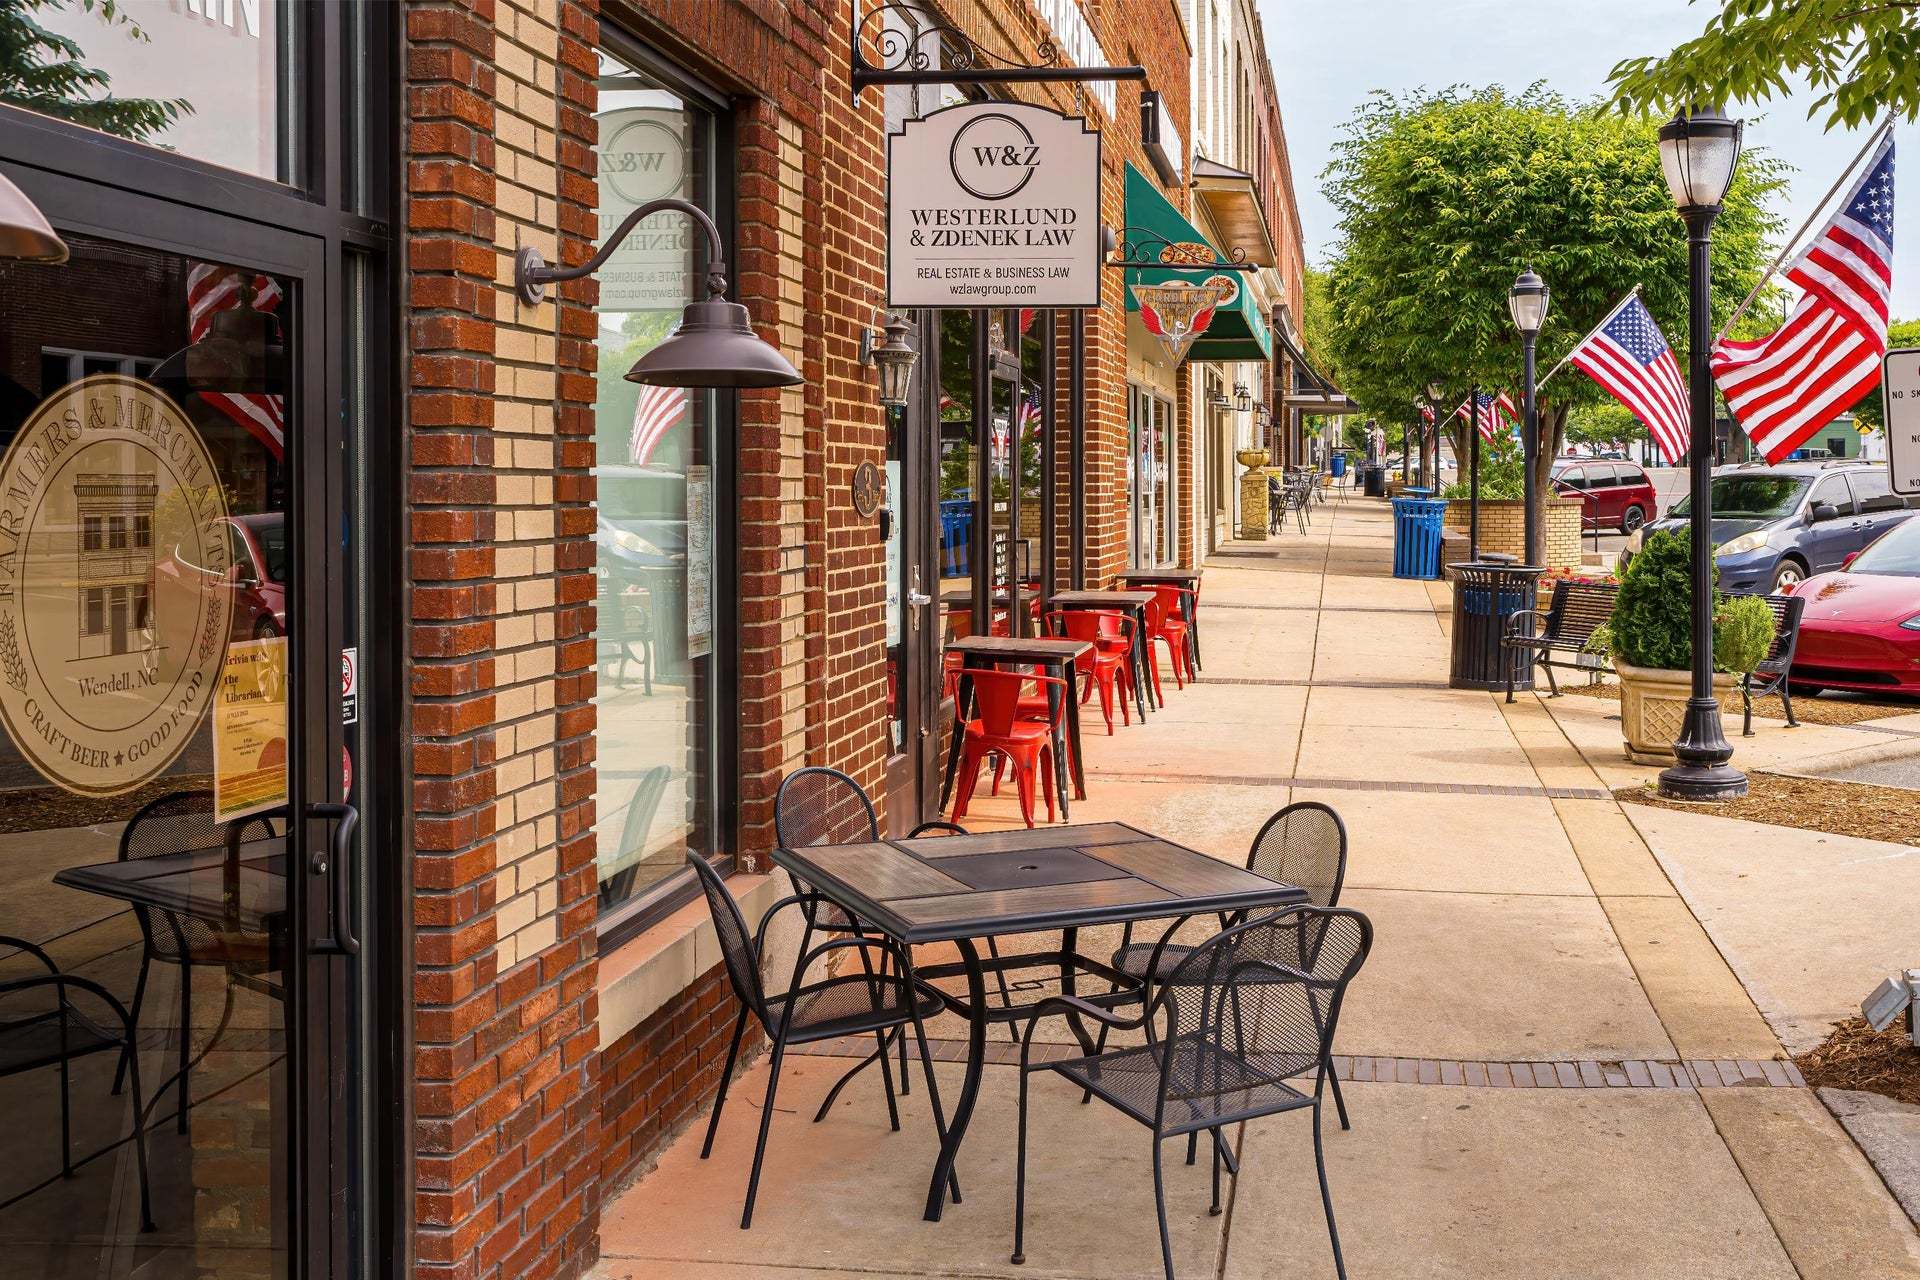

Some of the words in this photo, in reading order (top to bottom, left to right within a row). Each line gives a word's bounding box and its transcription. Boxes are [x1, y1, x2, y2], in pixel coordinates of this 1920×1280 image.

[972, 145, 1040, 167] W&Z
[910, 208, 1077, 226] WESTERLUND
[910, 229, 925, 247] &
[931, 229, 1020, 247] ZDENEK
[1024, 228, 1076, 247] LAW
[917, 268, 943, 279] REAL
[945, 268, 981, 279] ESTATE
[983, 268, 992, 279] &
[995, 267, 1046, 279] BUSINESS
[1048, 267, 1070, 279] LAW
[949, 282, 1037, 297] wzlawgroup.com
[1892, 391, 1904, 399] NO
[88, 397, 107, 430] &
[112, 395, 225, 588] MERCHANTS
[78, 674, 134, 698] Wendell,
[138, 667, 160, 688] NC
[224, 674, 239, 685] the
[24, 697, 68, 757] CRAFT
[72, 743, 110, 769] BEER
[128, 722, 172, 763] GOOD
[171, 671, 204, 732] FOOD
